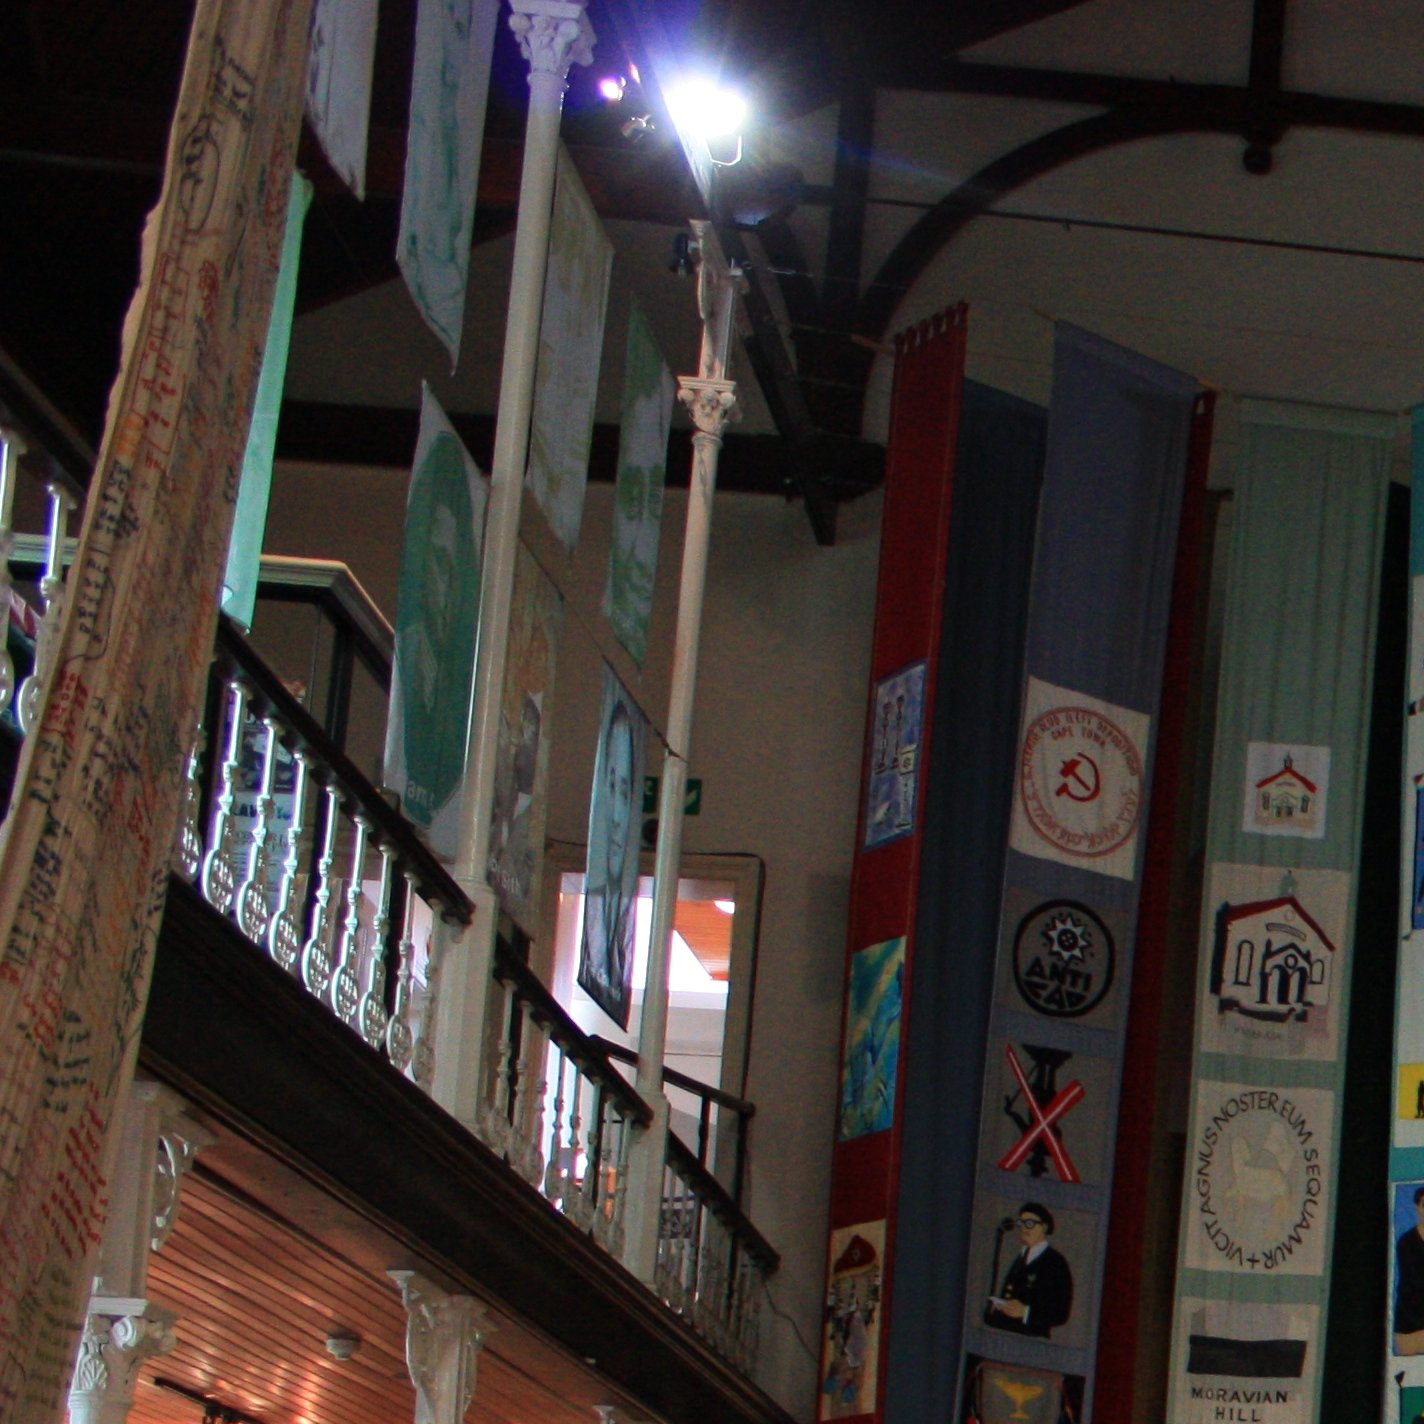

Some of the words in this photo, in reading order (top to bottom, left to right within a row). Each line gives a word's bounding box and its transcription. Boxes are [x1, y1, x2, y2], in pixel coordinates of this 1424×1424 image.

[1196, 1126, 1218, 1216] AGNUS
[1215, 1090, 1280, 1134] NOSTER
[1191, 1386, 1288, 1404] MORAVIAN
[1215, 1407, 1261, 1422] HILL
